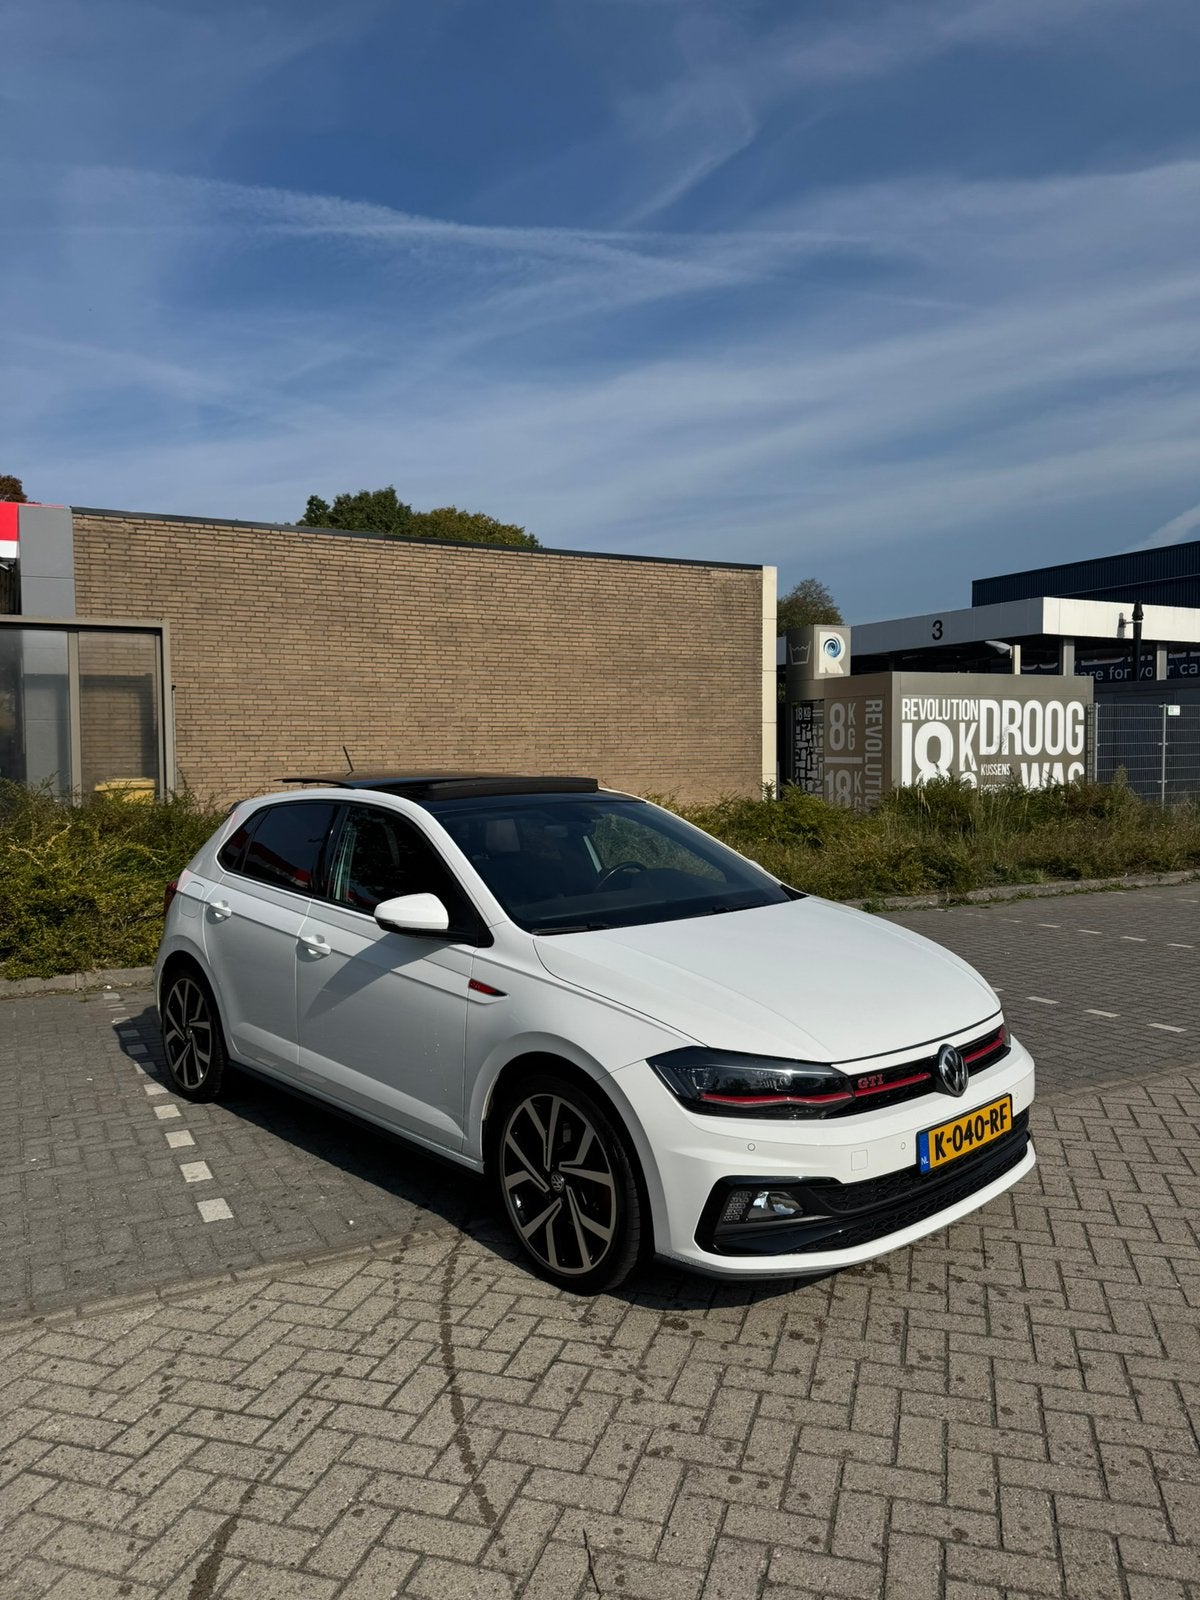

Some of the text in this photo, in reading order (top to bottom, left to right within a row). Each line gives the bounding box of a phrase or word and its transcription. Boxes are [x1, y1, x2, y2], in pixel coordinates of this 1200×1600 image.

[932, 620, 943, 640] 3
[1109, 666, 1131, 680] for
[1139, 664, 1174, 680] yor
[902, 698, 979, 721] REVOLUTION
[979, 699, 1085, 756] DROOG
[865, 699, 883, 809] REVOLUTIO
[980, 763, 1011, 776] KUSSENS
[857, 1073, 883, 1089] GTI
[934, 1102, 1008, 1161] K-040-RF
[920, 1155, 929, 1166] NL
